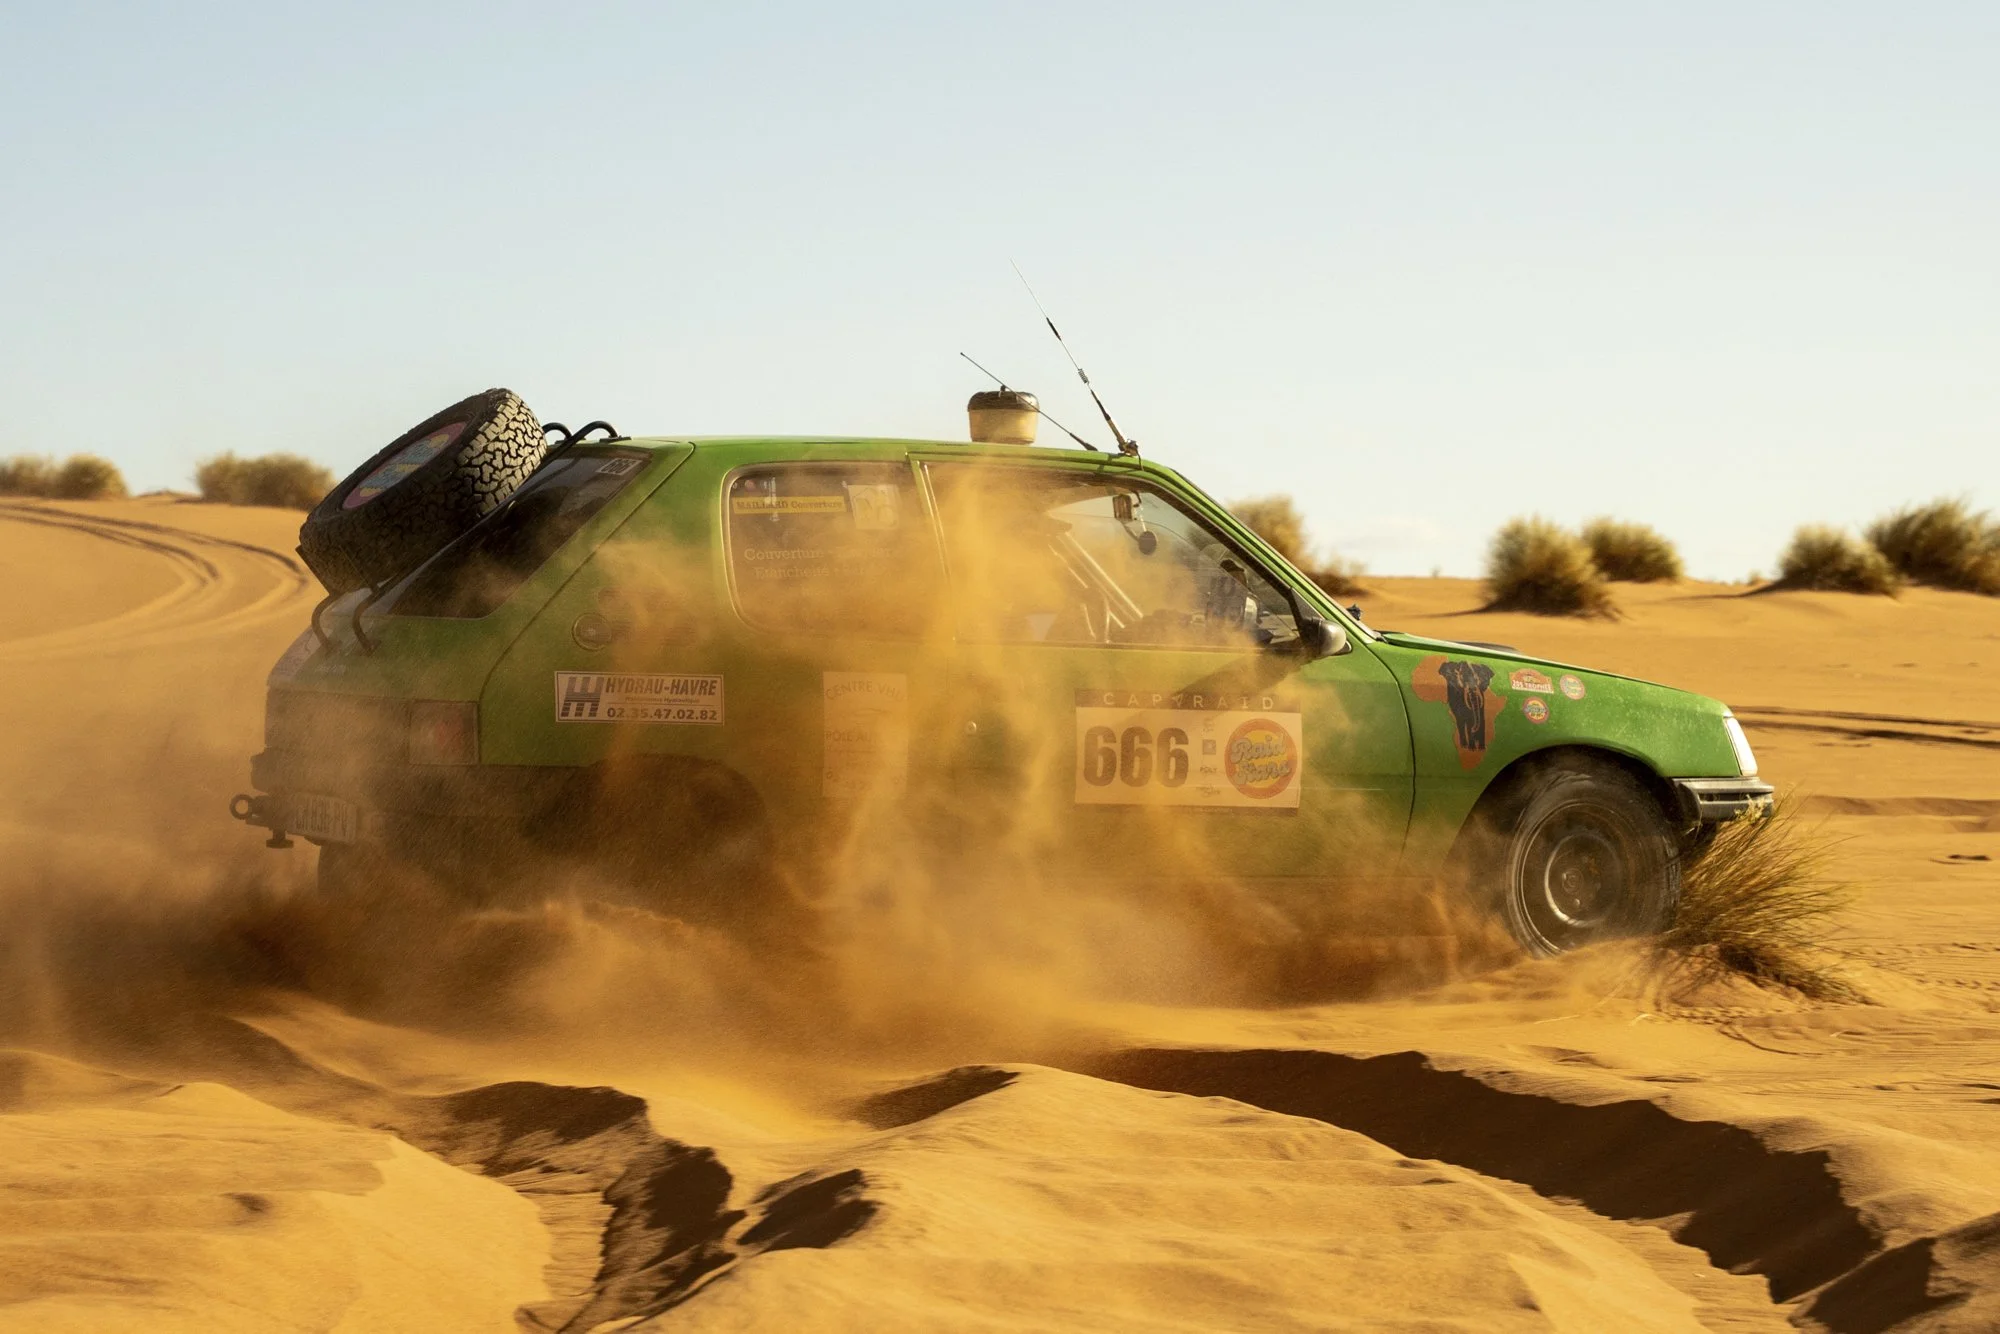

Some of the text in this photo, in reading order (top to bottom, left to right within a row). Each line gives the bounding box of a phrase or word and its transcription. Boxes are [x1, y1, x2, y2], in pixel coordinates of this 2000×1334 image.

[605, 677, 718, 696] HYDRAU-HAVRE
[825, 680, 873, 700] CENTRE
[607, 707, 718, 720] 02.35.47.02.82
[1083, 725, 1190, 788] 666
[1230, 731, 1288, 765] Raid
